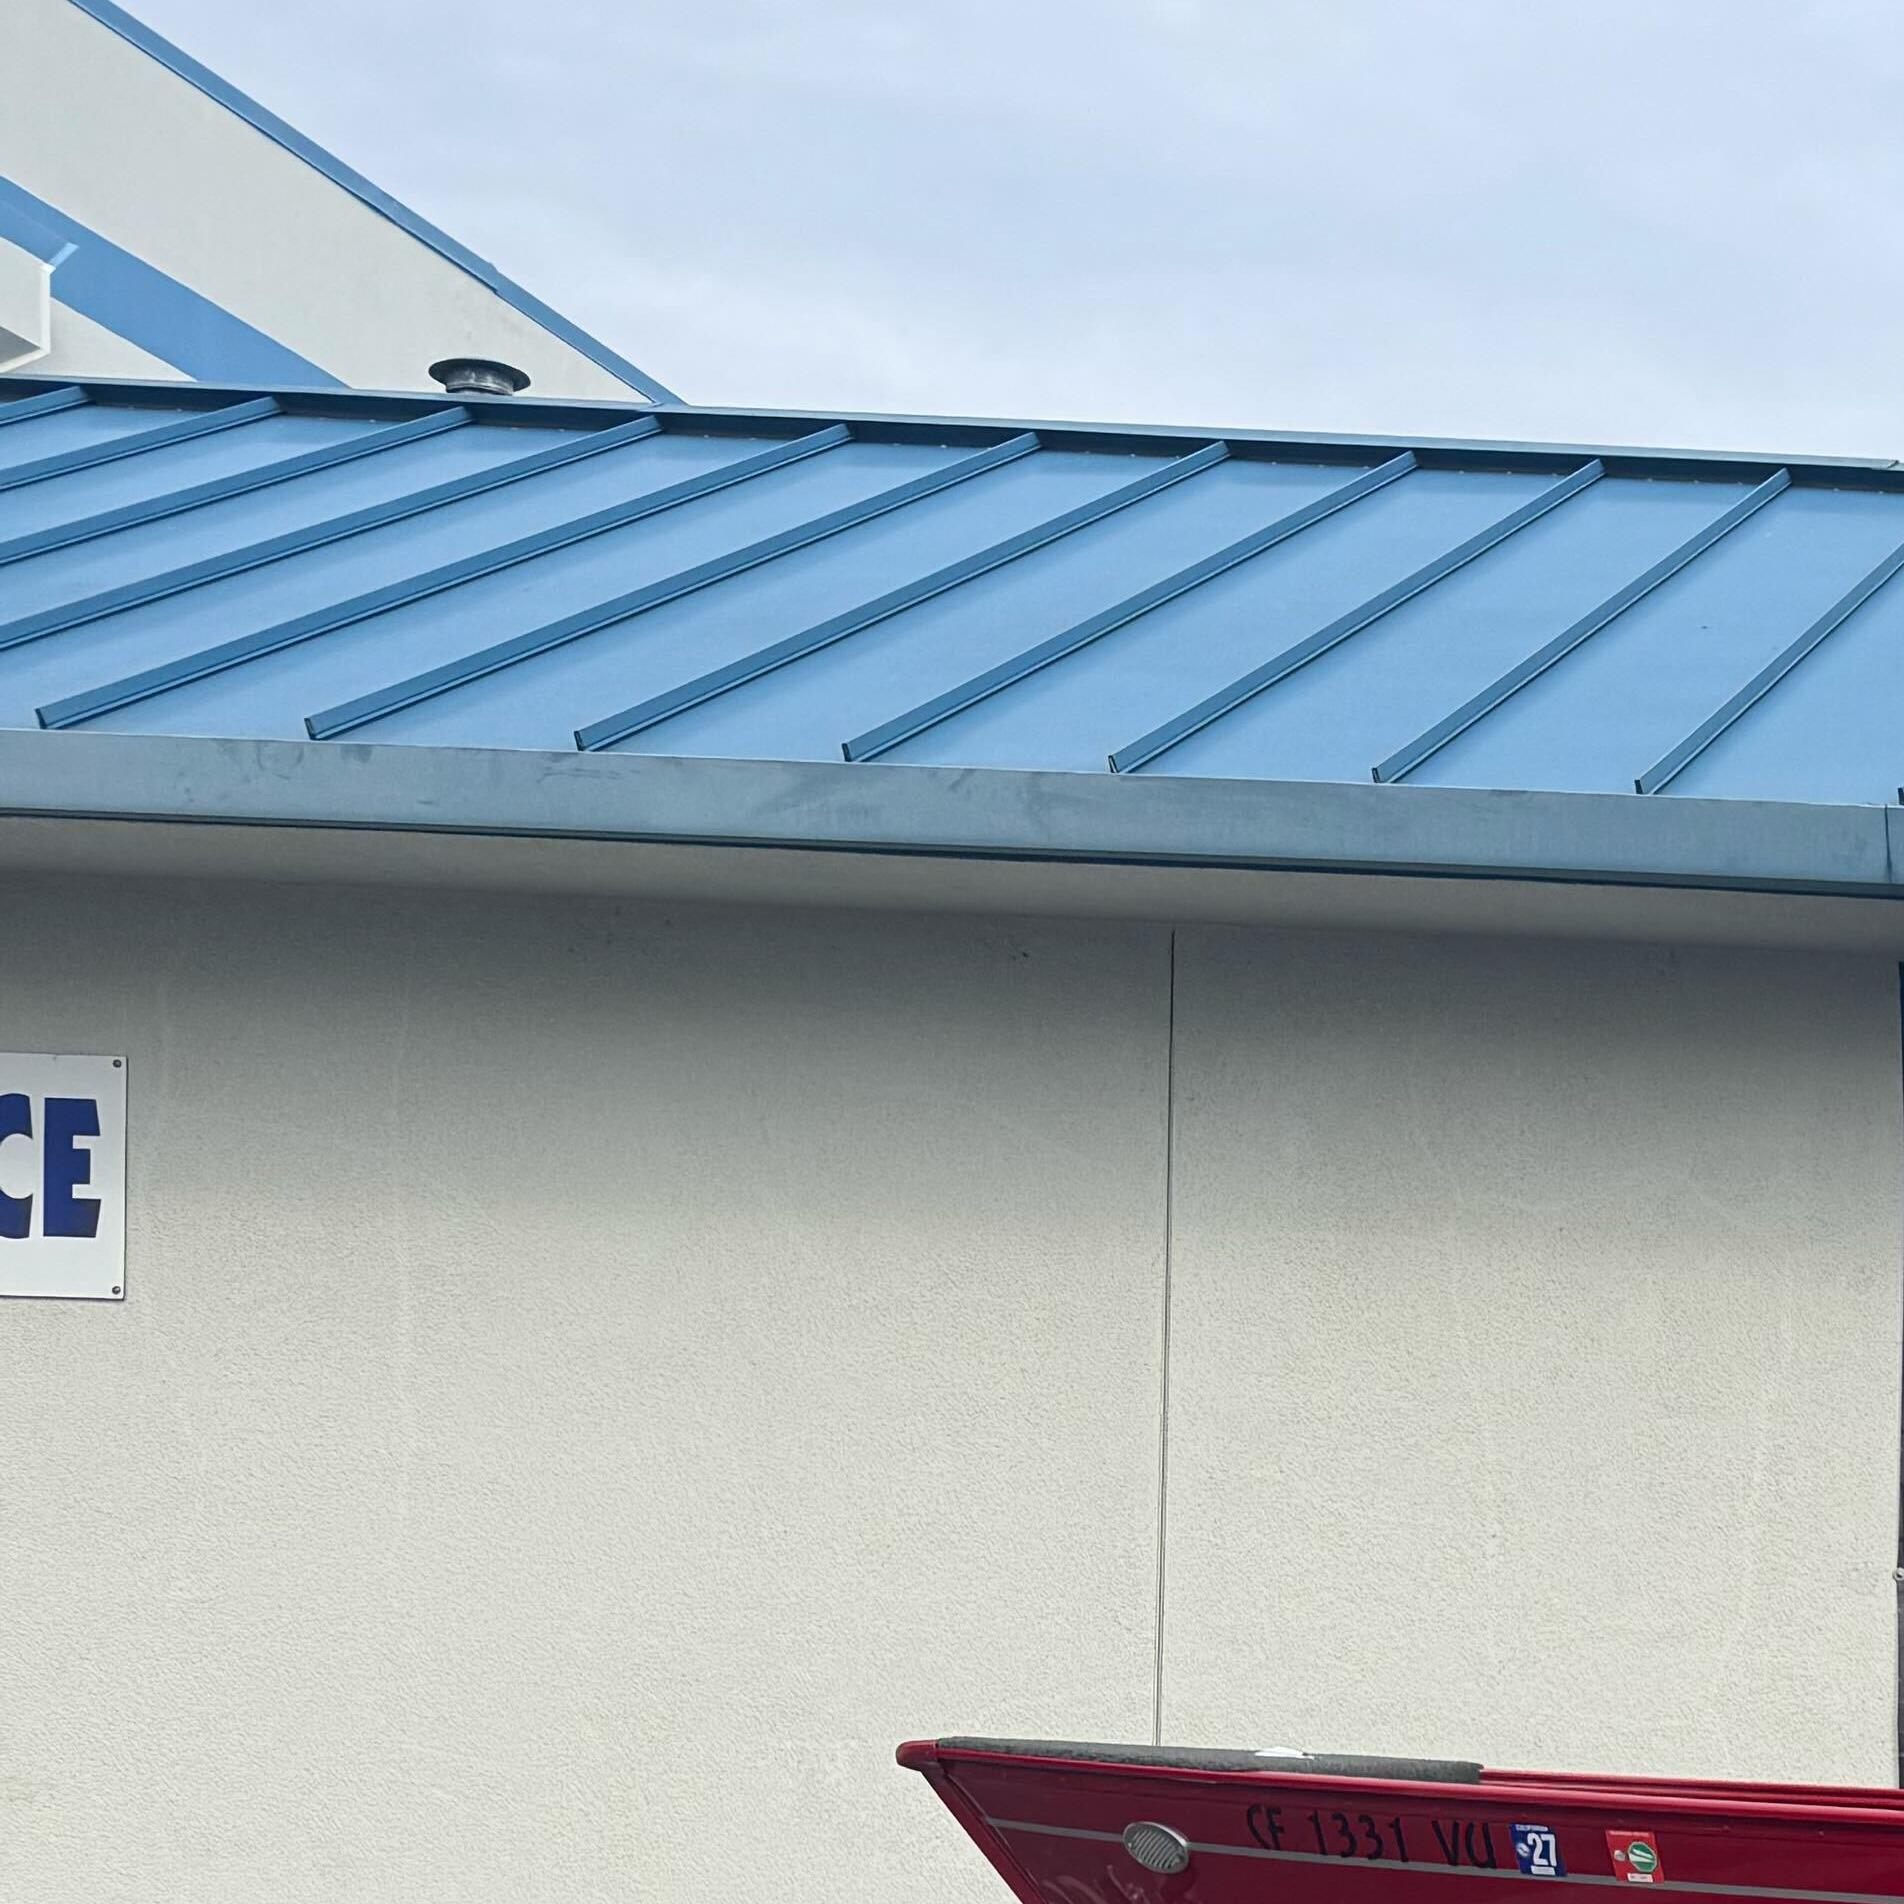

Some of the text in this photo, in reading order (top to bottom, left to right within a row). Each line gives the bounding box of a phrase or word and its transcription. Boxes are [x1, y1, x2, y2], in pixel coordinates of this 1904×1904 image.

[1246, 1803, 1285, 1851] CF
[1306, 1809, 1409, 1863] 1331
[1526, 1832, 1558, 1867] 27
